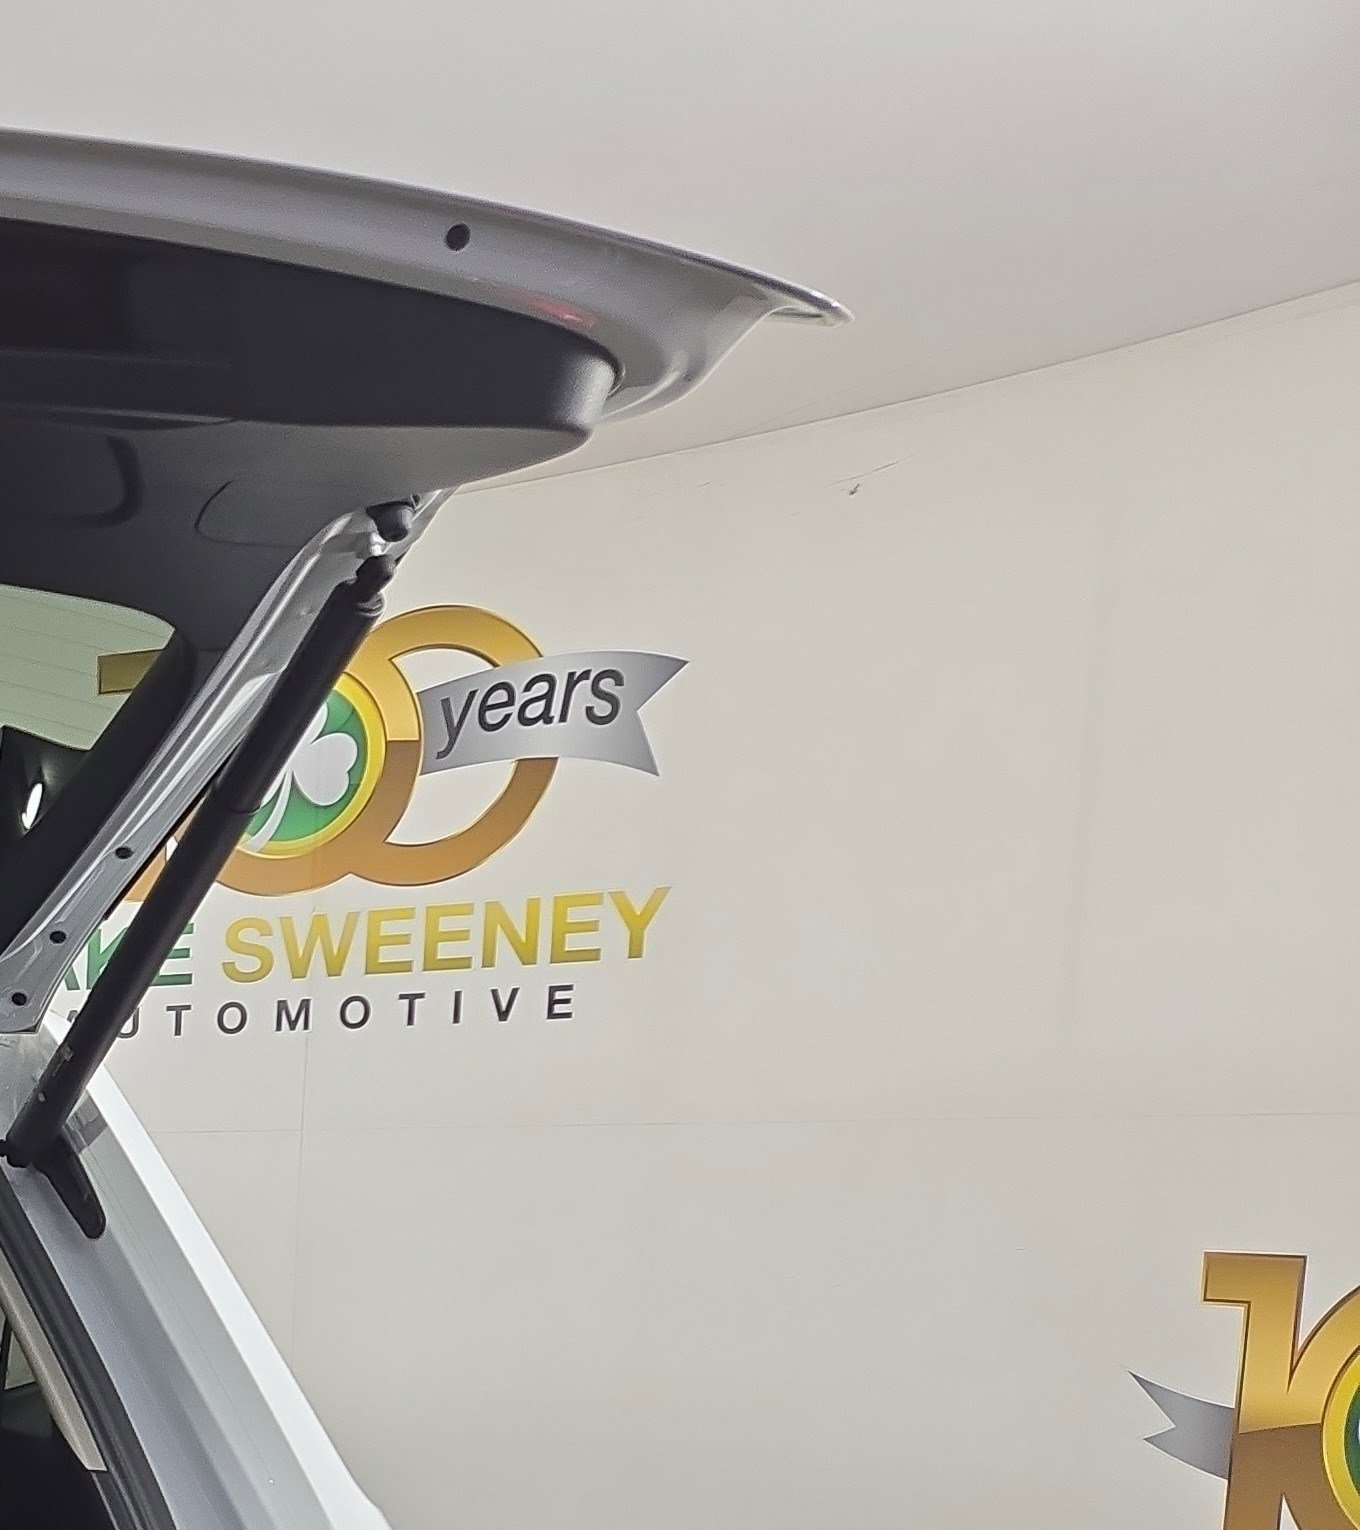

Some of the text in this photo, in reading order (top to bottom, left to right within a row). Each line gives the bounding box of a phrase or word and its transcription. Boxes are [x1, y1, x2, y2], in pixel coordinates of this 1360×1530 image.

[435, 666, 625, 759] years
[222, 886, 672, 984] SWEENEY
[67, 984, 575, 1038] UTOMOTIVE
